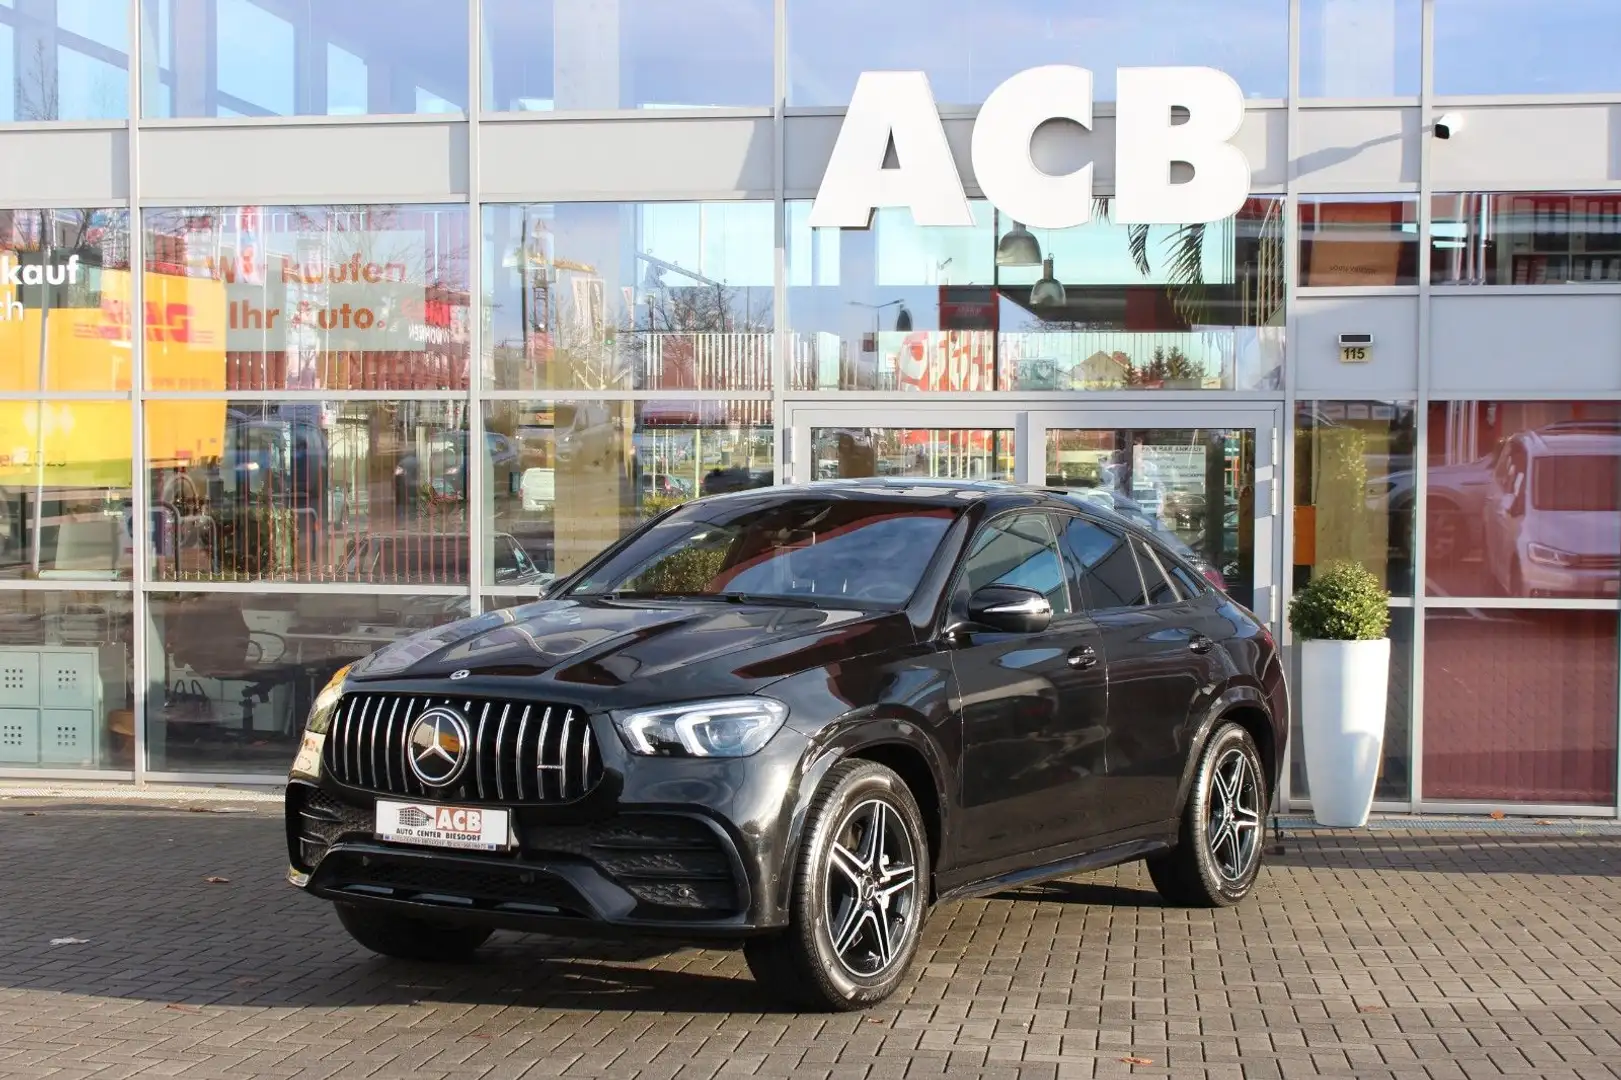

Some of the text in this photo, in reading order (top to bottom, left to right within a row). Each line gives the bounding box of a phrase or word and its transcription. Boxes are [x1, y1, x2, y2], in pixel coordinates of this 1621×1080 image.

[809, 64, 1251, 229] ACB
[1, 254, 79, 285] kauf
[229, 298, 386, 330] Ihr uto.
[1344, 348, 1365, 359] 115
[437, 808, 482, 832] ACB
[396, 828, 414, 836] AUTO
[417, 829, 441, 839] CENTER
[445, 832, 482, 842] BIESDORF
